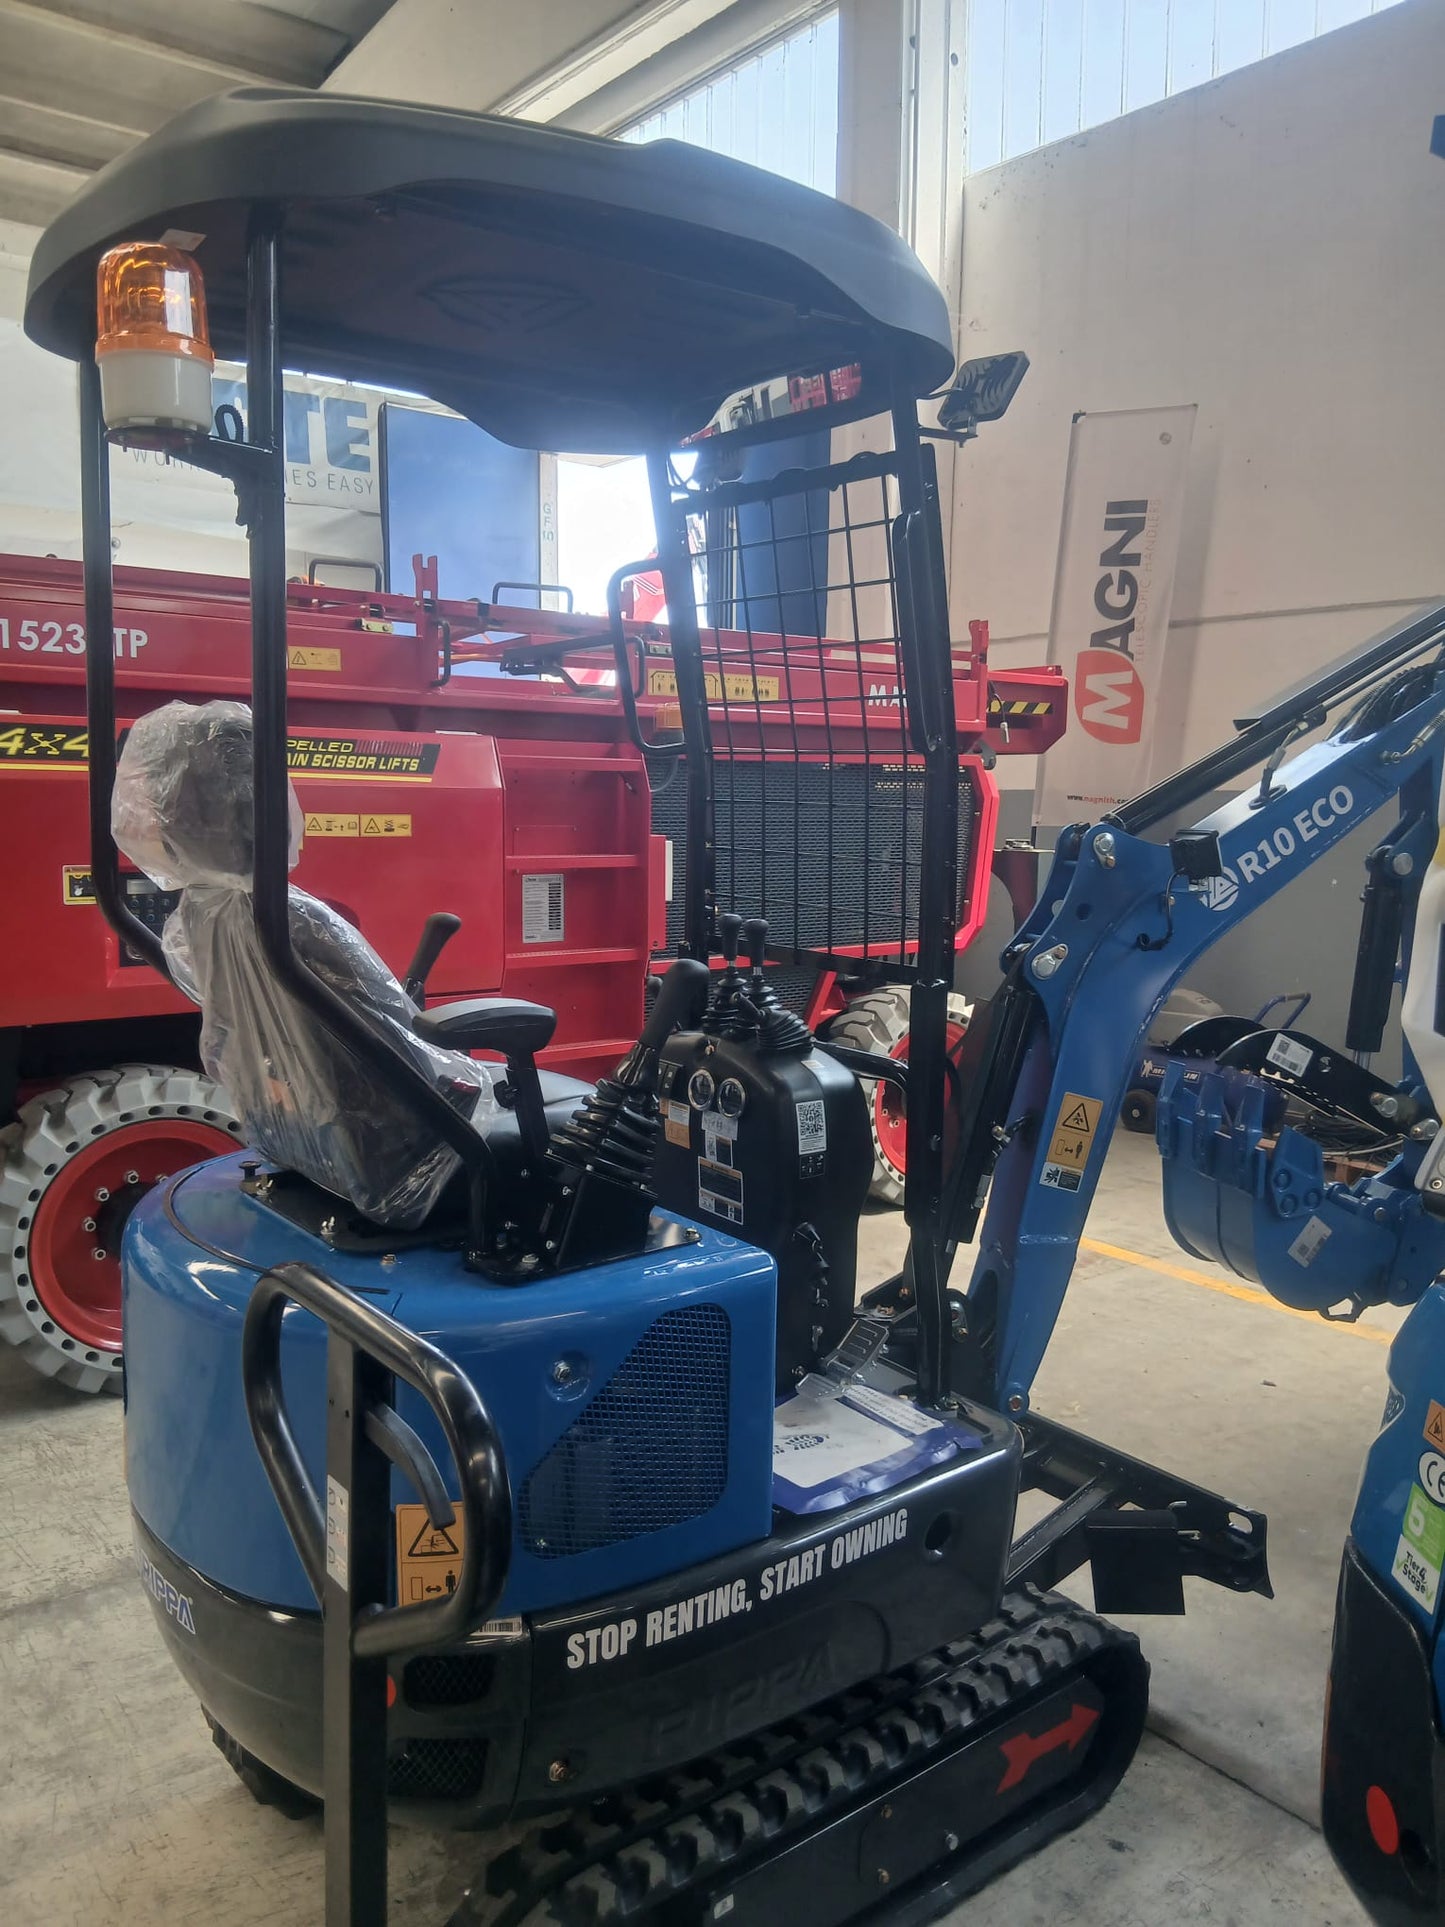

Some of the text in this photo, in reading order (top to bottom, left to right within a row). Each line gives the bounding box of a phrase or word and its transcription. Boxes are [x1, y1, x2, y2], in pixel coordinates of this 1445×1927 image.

[327, 473, 374, 494] EASY
[1081, 499, 1149, 731] MAGNI
[311, 754, 377, 769] SCISSOR
[379, 757, 420, 772] LIFTS
[1236, 785, 1354, 884] R10 ECO
[566, 1508, 909, 1670] STOP RENTING, START OWNING
[1402, 1563, 1426, 1594] Stage
